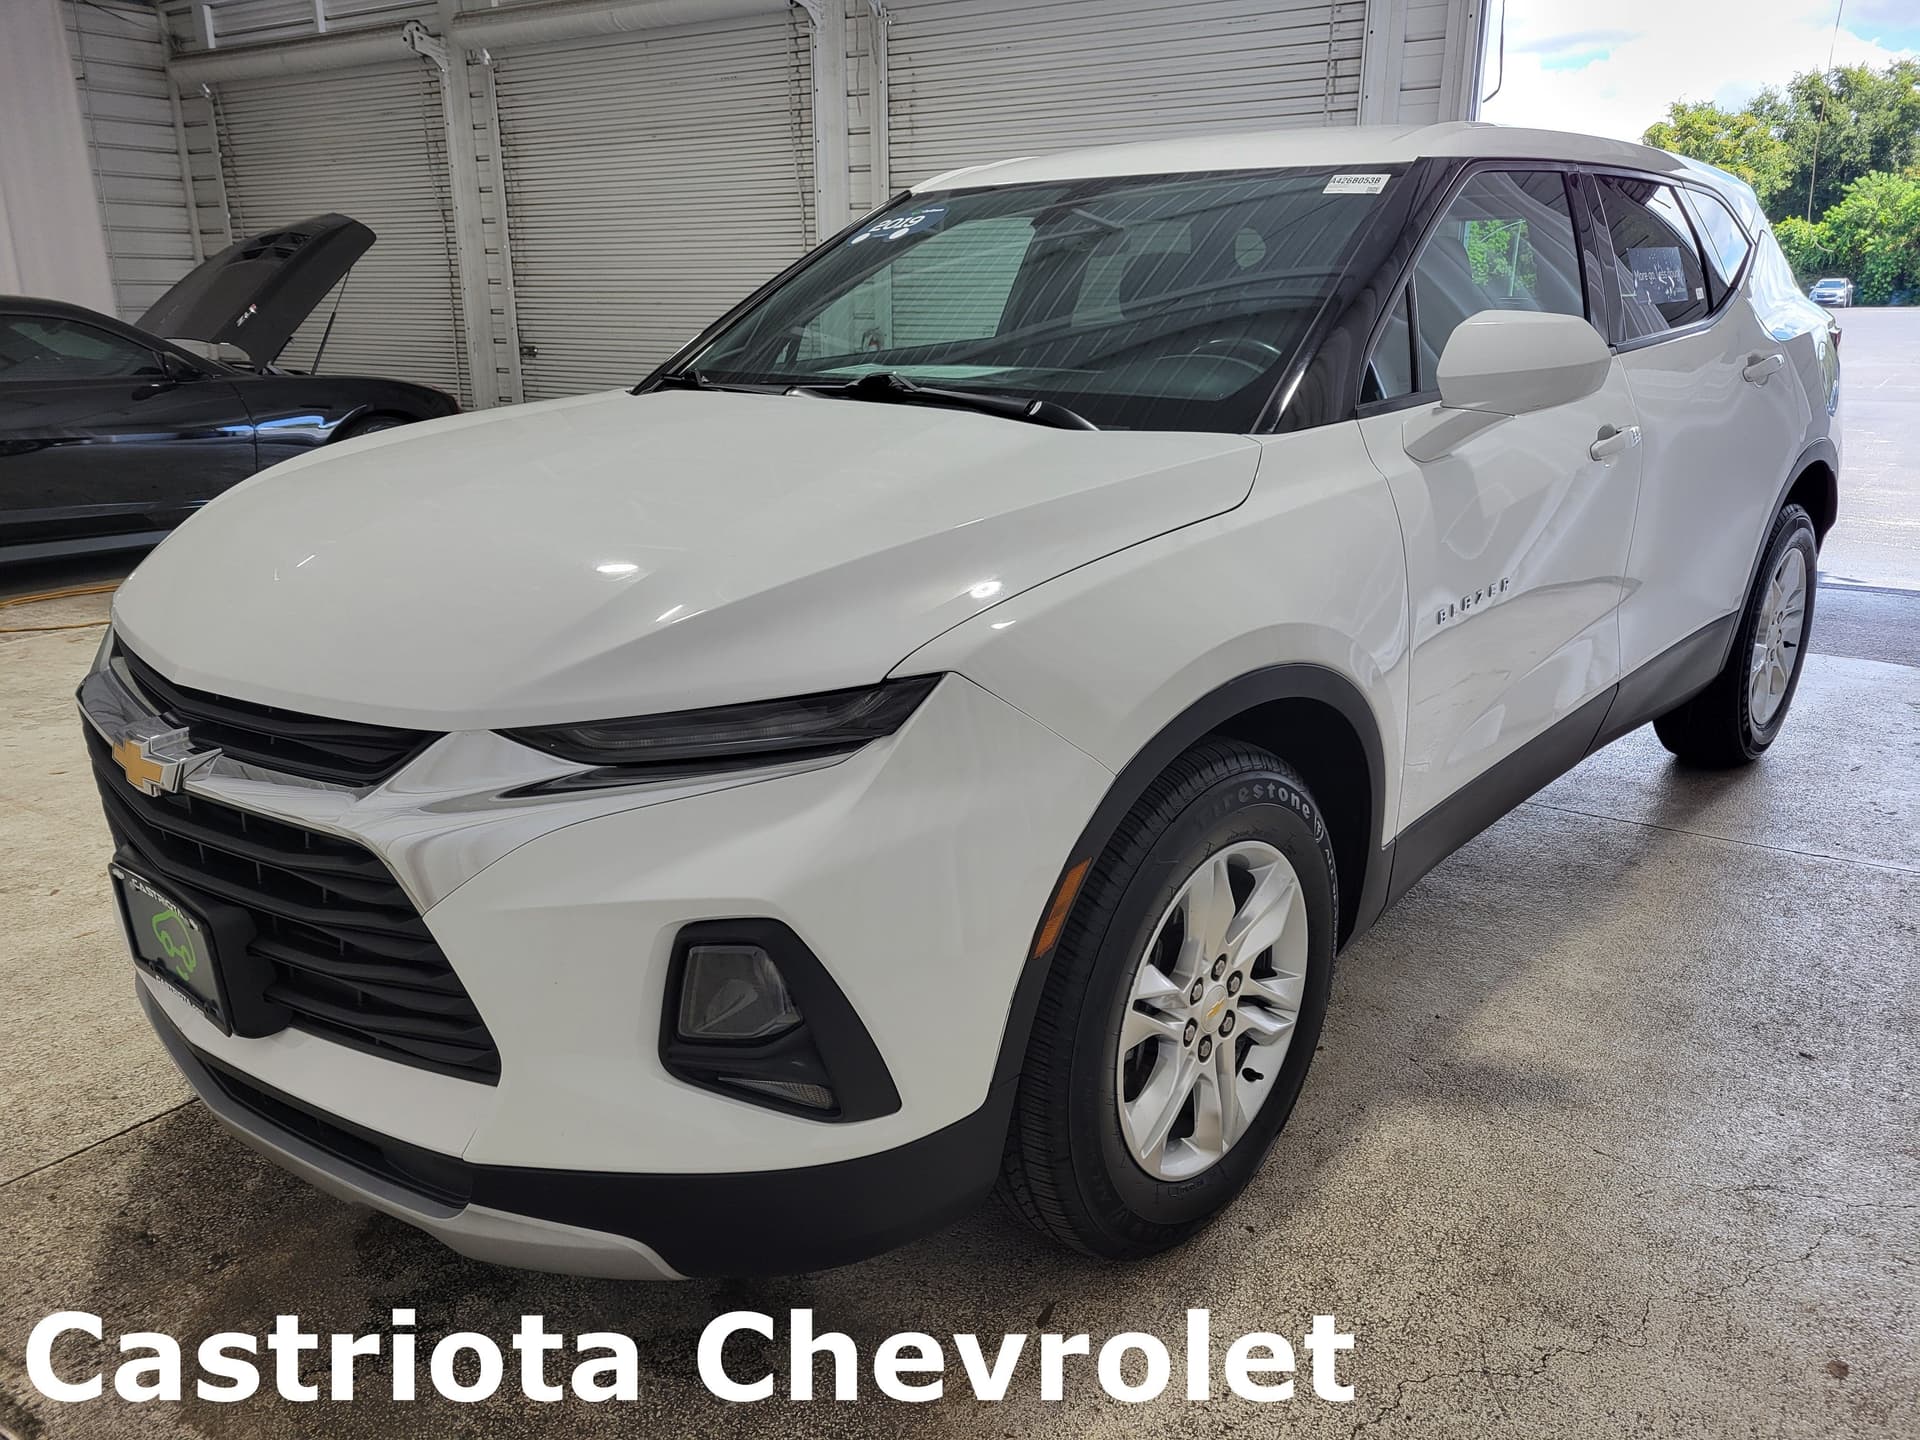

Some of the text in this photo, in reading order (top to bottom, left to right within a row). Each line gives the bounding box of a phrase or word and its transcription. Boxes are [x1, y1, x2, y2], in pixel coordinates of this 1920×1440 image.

[868, 215, 926, 232] 2019
[1437, 577, 1510, 624] BLAZER
[129, 878, 186, 920] CASTRIOTA
